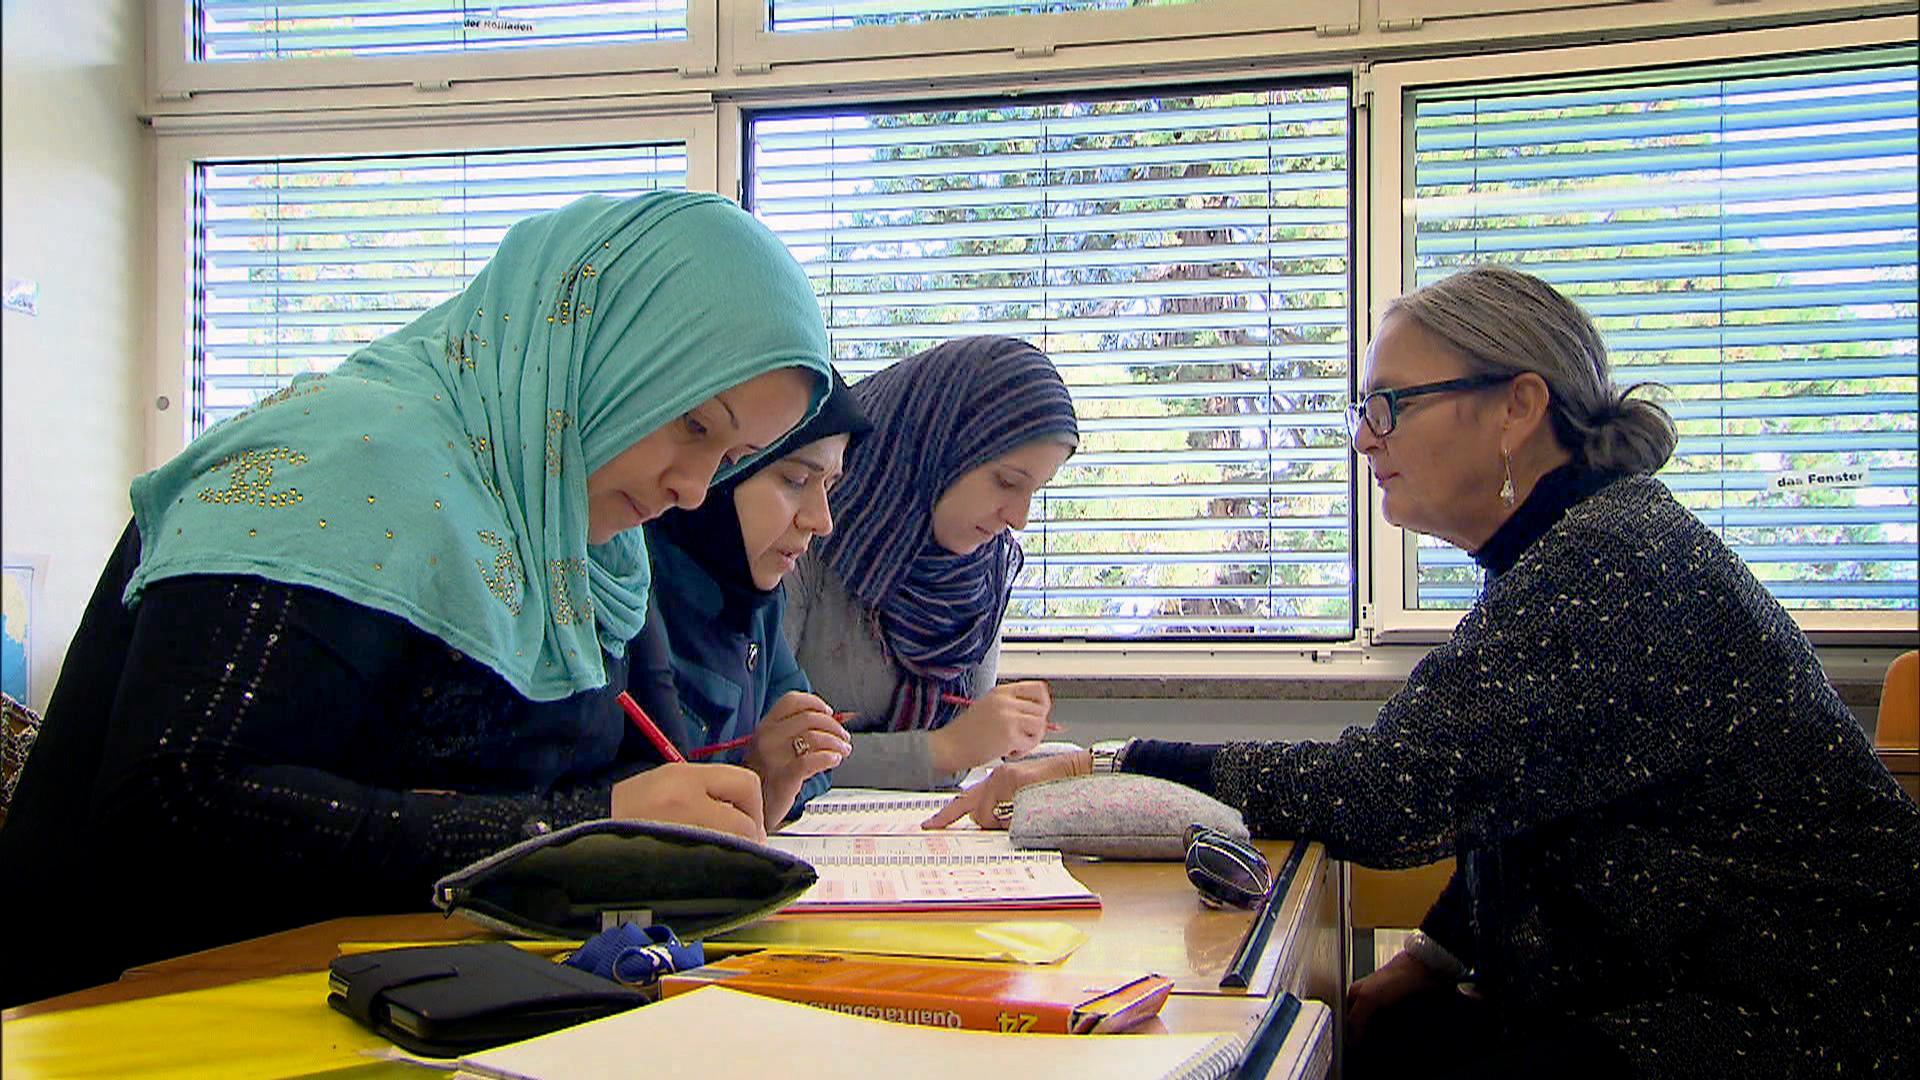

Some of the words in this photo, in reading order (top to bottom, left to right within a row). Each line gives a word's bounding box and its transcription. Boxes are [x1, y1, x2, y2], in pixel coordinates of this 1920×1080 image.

[464, 19, 480, 28] der
[1777, 476, 1803, 487] das
[1808, 472, 1863, 484] Fenster
[998, 1012, 1039, 1033] 24
